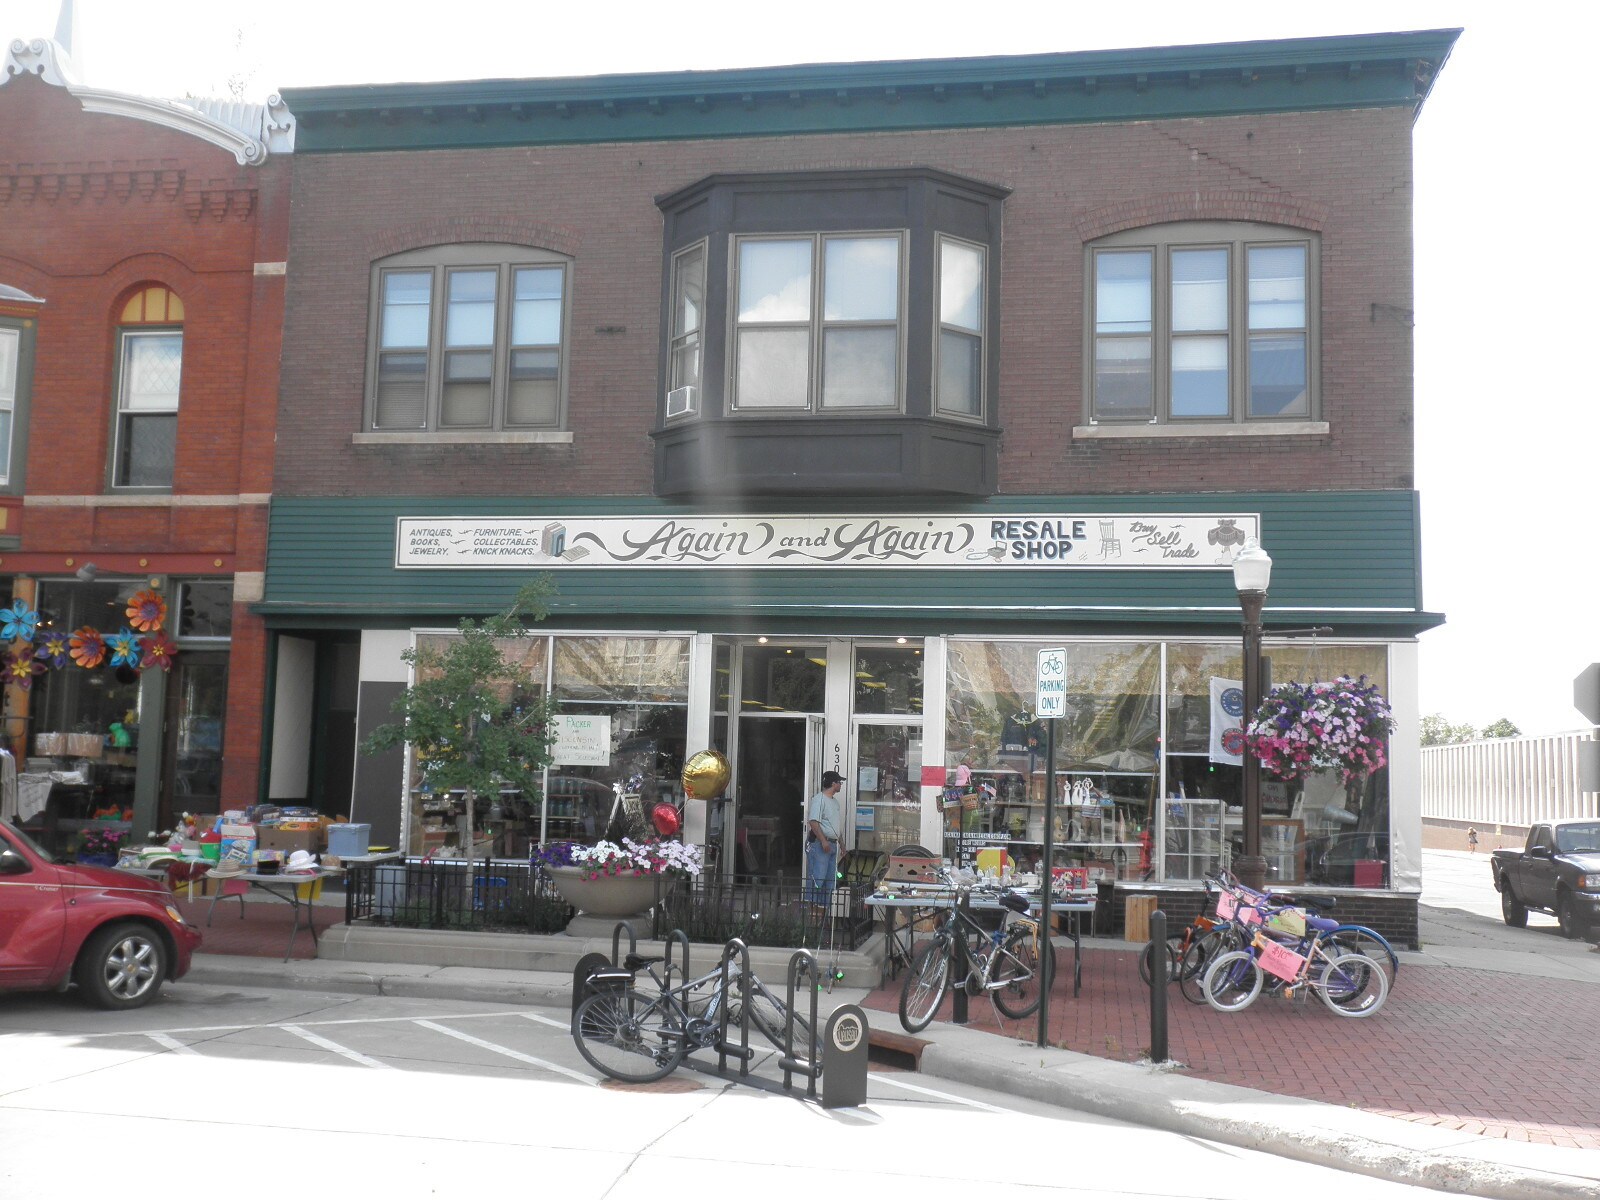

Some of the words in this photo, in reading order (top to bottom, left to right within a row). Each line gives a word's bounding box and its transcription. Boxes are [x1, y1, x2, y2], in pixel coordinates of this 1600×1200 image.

[409, 528, 453, 538] ANTIQUES,
[473, 528, 522, 537] FURNITURE,
[990, 520, 1087, 540] RESALE
[1129, 521, 1158, 538] Buy
[410, 538, 441, 547] BOOKS,
[473, 538, 539, 547] COLLECTABLES,
[622, 519, 775, 562] Again
[779, 527, 830, 548] and
[833, 519, 975, 562] Again
[1147, 531, 1182, 546] Sell
[472, 547, 499, 555] KNICK
[1011, 540, 1074, 560] SHOP
[1161, 542, 1200, 559] Trade
[1040, 680, 1064, 692] PARKING
[1042, 696, 1060, 709] ONLY
